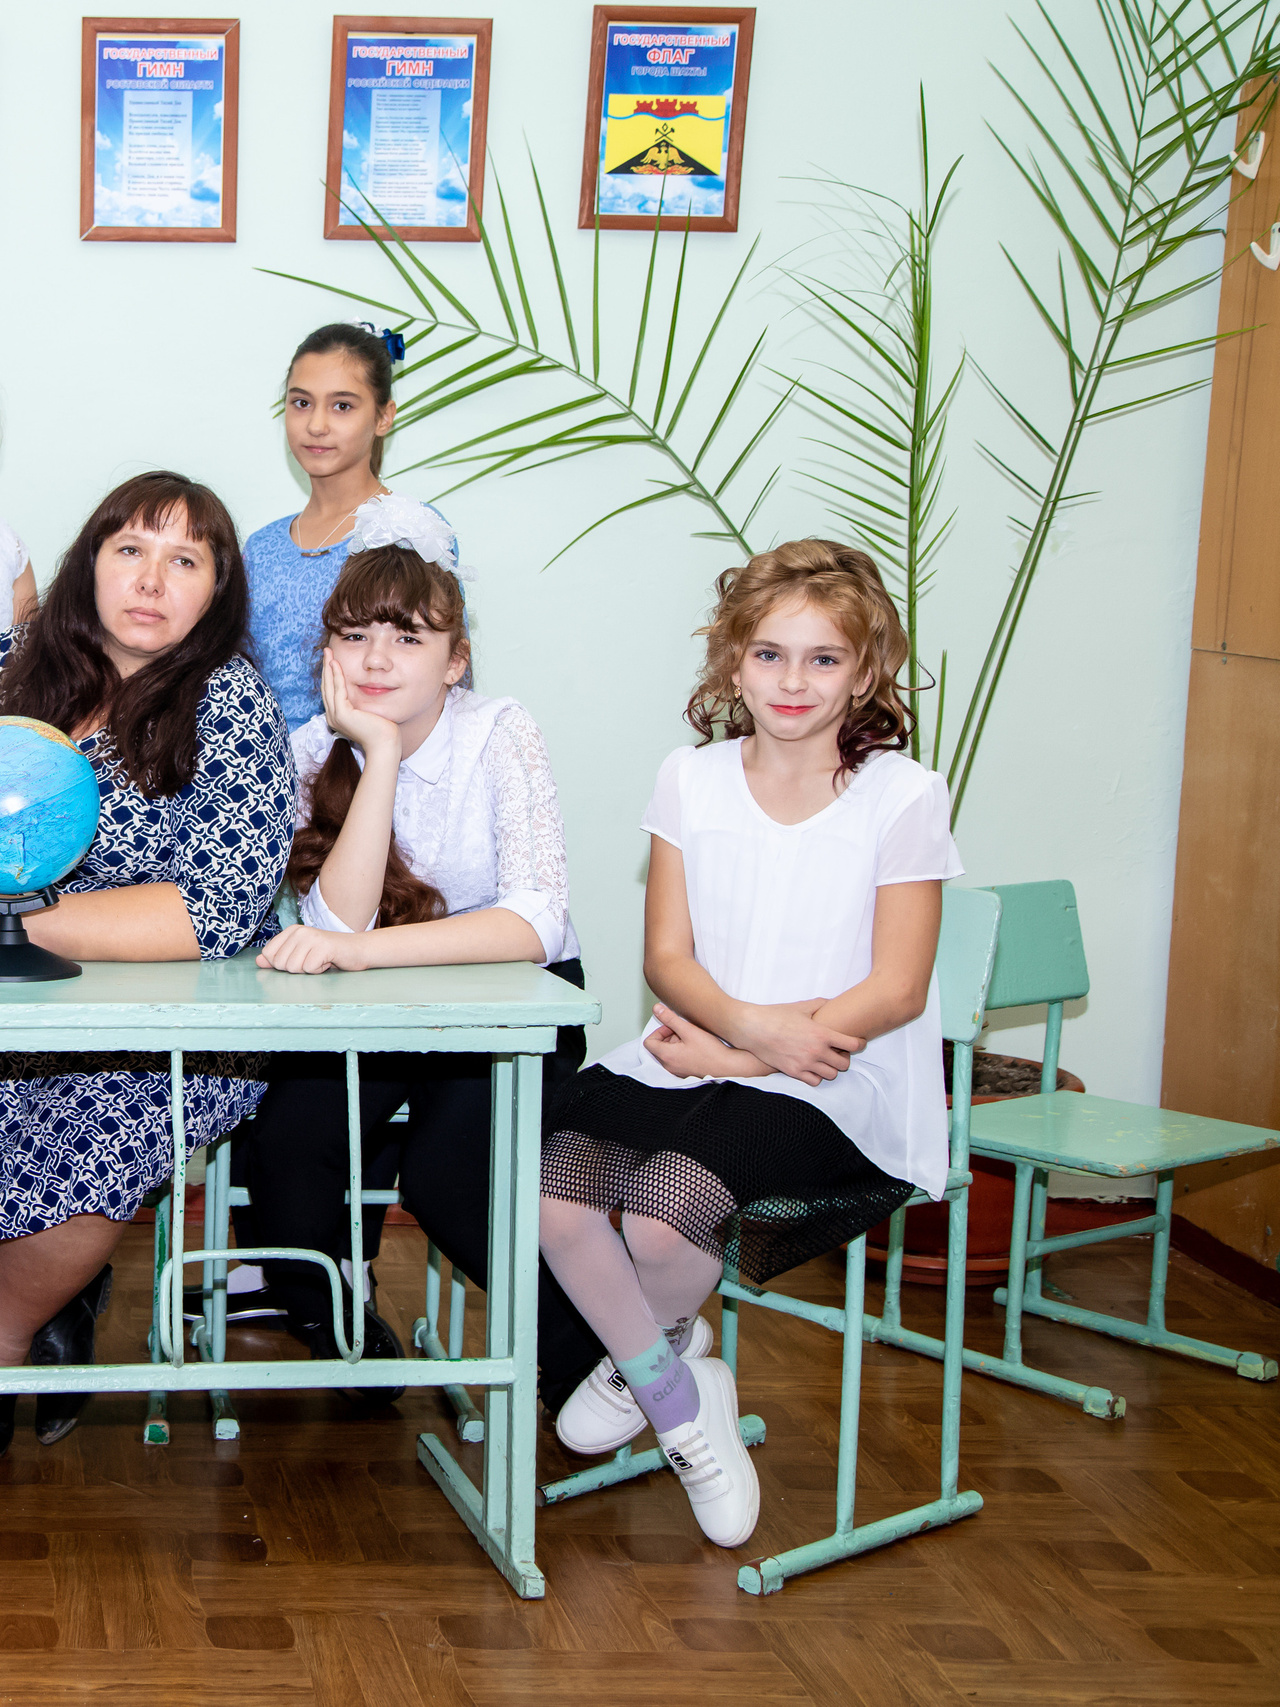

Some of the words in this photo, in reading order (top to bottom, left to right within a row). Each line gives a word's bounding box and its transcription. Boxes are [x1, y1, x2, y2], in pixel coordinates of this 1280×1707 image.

[613, 33, 731, 48] ГОСУДАРСТВЕННЫЙ
[103, 47, 219, 61] ГОСУДАРСТВЕННЫЙ
[352, 45, 469, 60] ГОСУДАРСТВЕННЫЙ
[646, 48, 696, 65] ФЛАГ
[137, 62, 185, 78] ГИМН
[386, 60, 434, 76] ГИМН
[631, 66, 669, 77] ГОРОДА
[670, 66, 708, 77] ШАХТЫ
[106, 78, 169, 90] РОСТОВСКОЙ
[170, 79, 215, 91] ОБЛАСТИ
[348, 76, 411, 89] РОССИЙСКОЙ
[413, 77, 470, 90] ФЕДЕРАЦИИ
